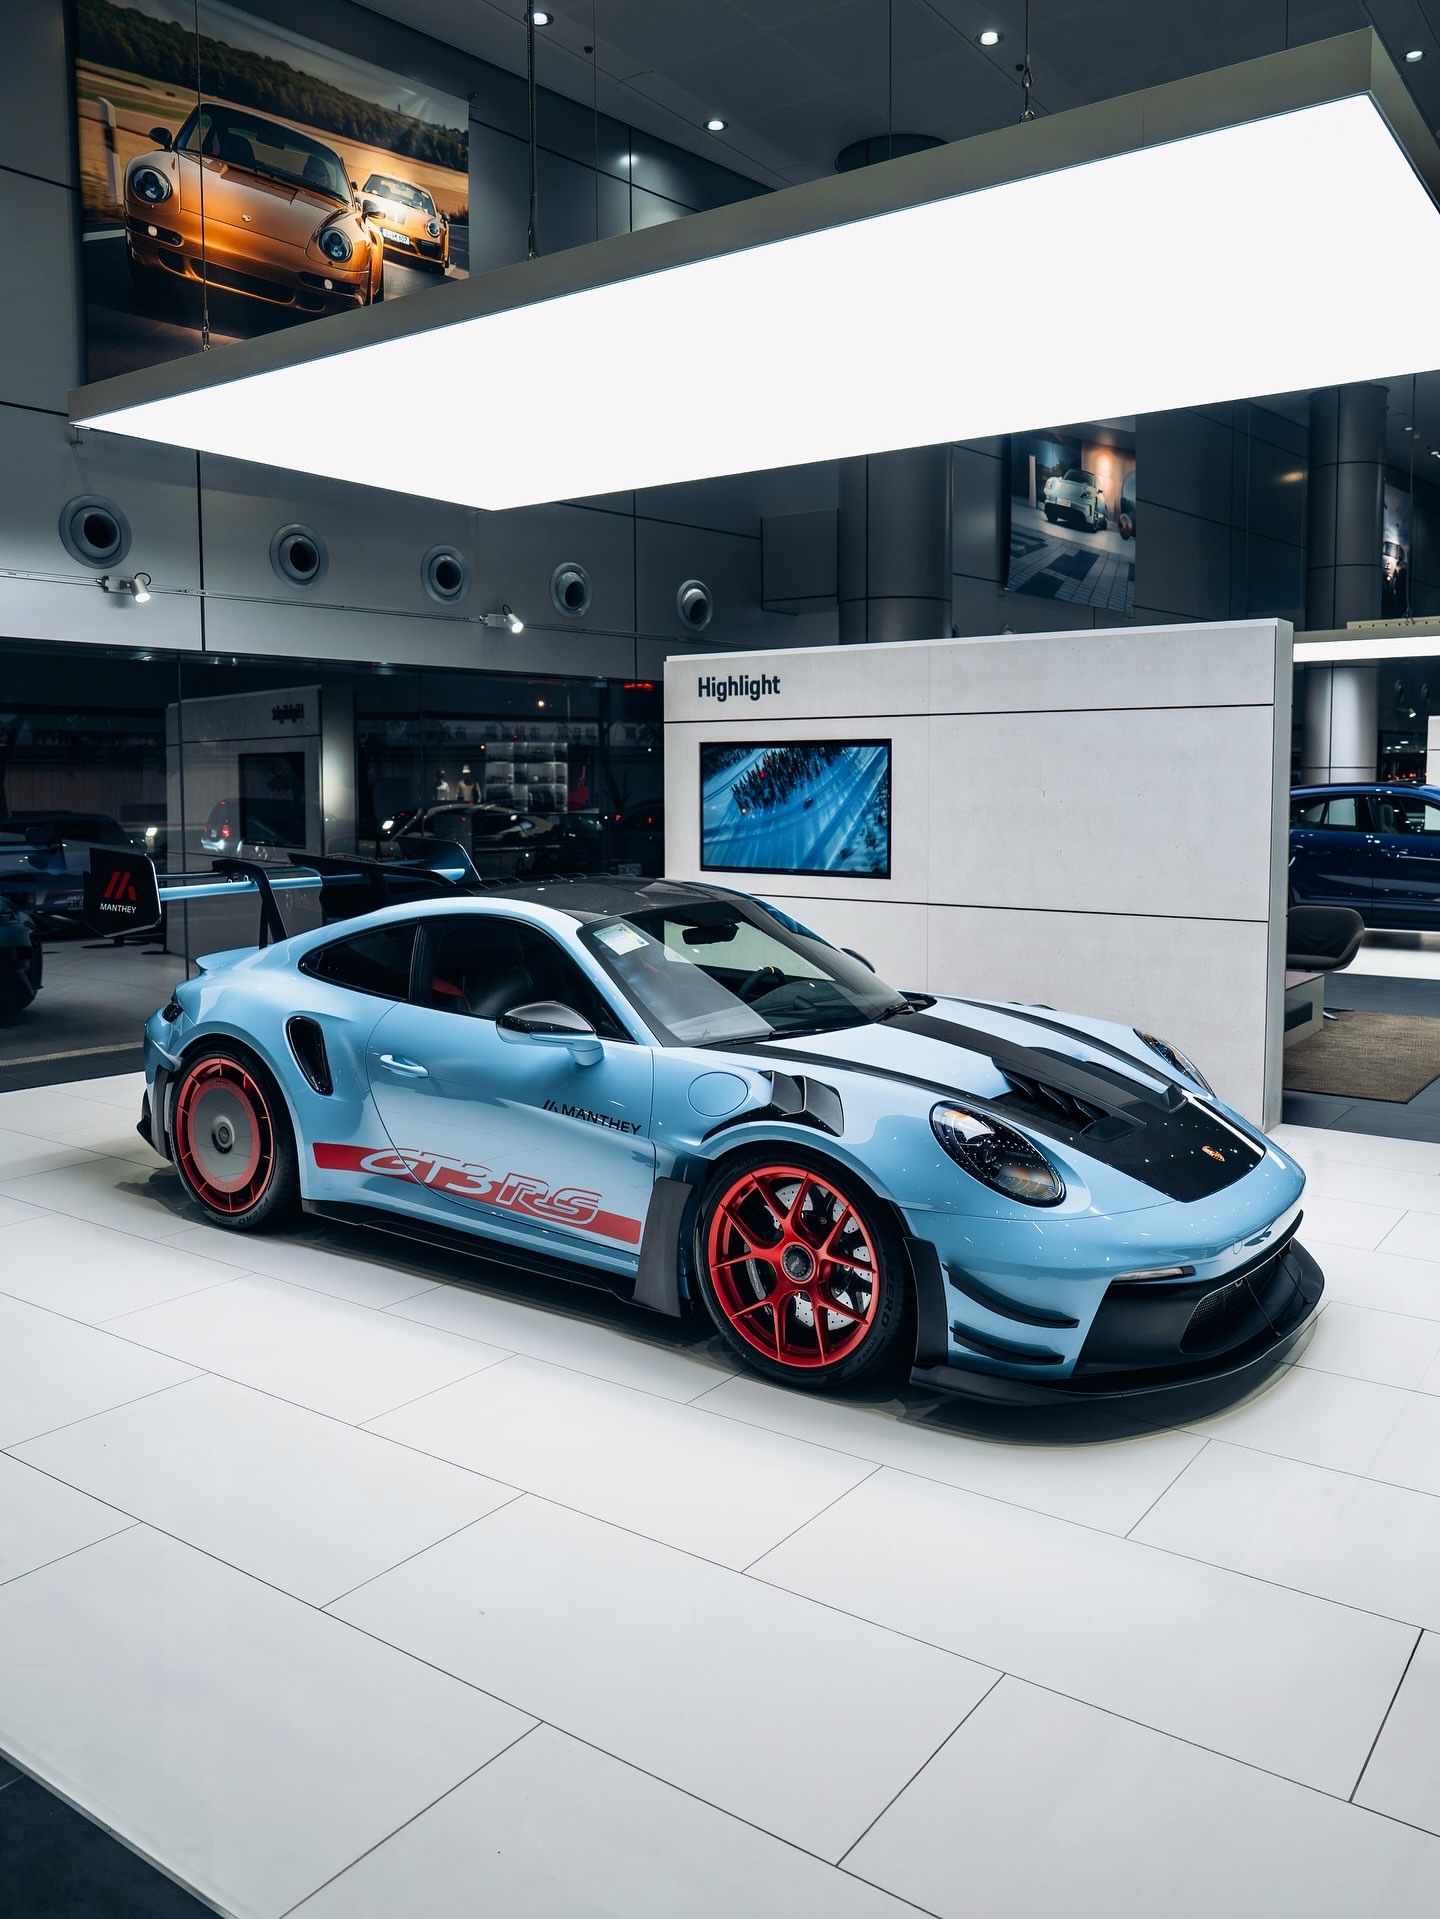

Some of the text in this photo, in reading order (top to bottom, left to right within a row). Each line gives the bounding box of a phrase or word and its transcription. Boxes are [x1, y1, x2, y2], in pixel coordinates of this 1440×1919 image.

[698, 674, 781, 702] Highlight
[99, 902, 137, 915] MANTHEY
[561, 1103, 642, 1135] MANTHEY
